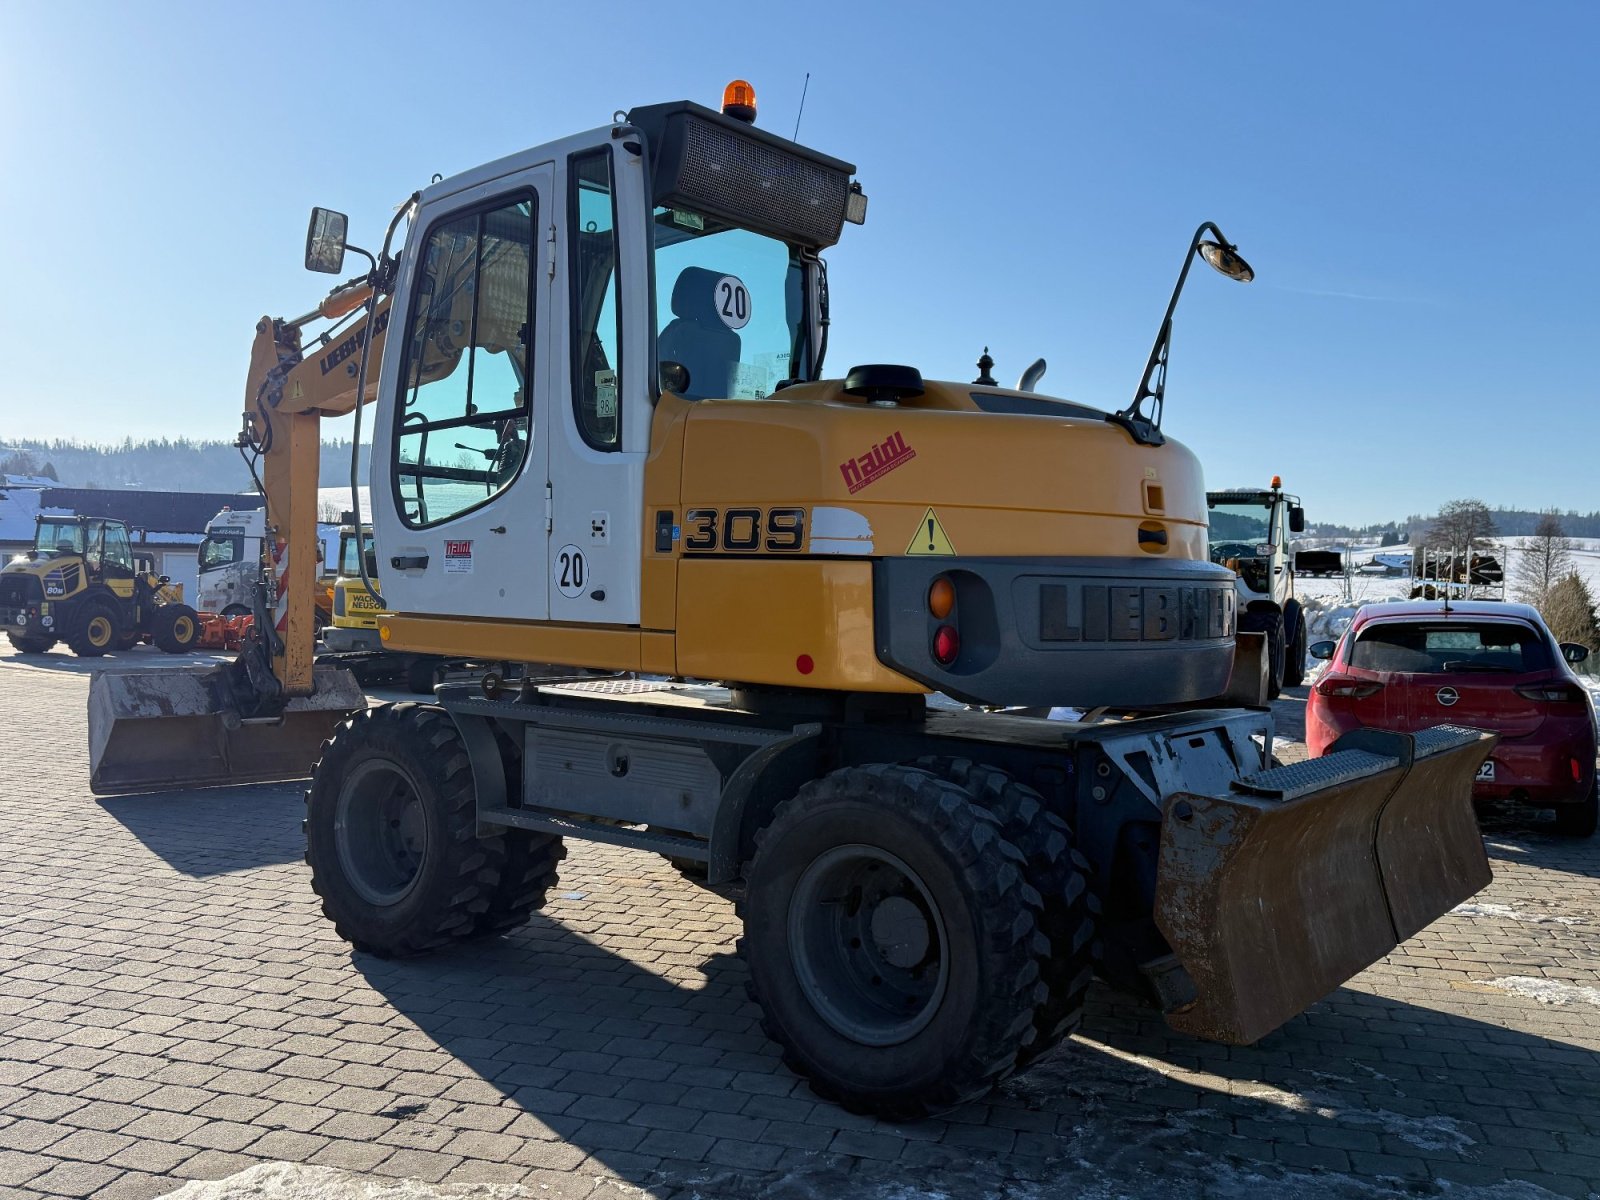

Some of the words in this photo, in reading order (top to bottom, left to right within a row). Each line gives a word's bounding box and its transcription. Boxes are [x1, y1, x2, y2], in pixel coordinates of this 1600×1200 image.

[721, 282, 746, 320] 20
[600, 399, 610, 413] 98
[839, 430, 912, 488] Haidl
[685, 507, 806, 552] 309
[560, 552, 583, 588] 20
[1040, 584, 1235, 641] LIEBHER
